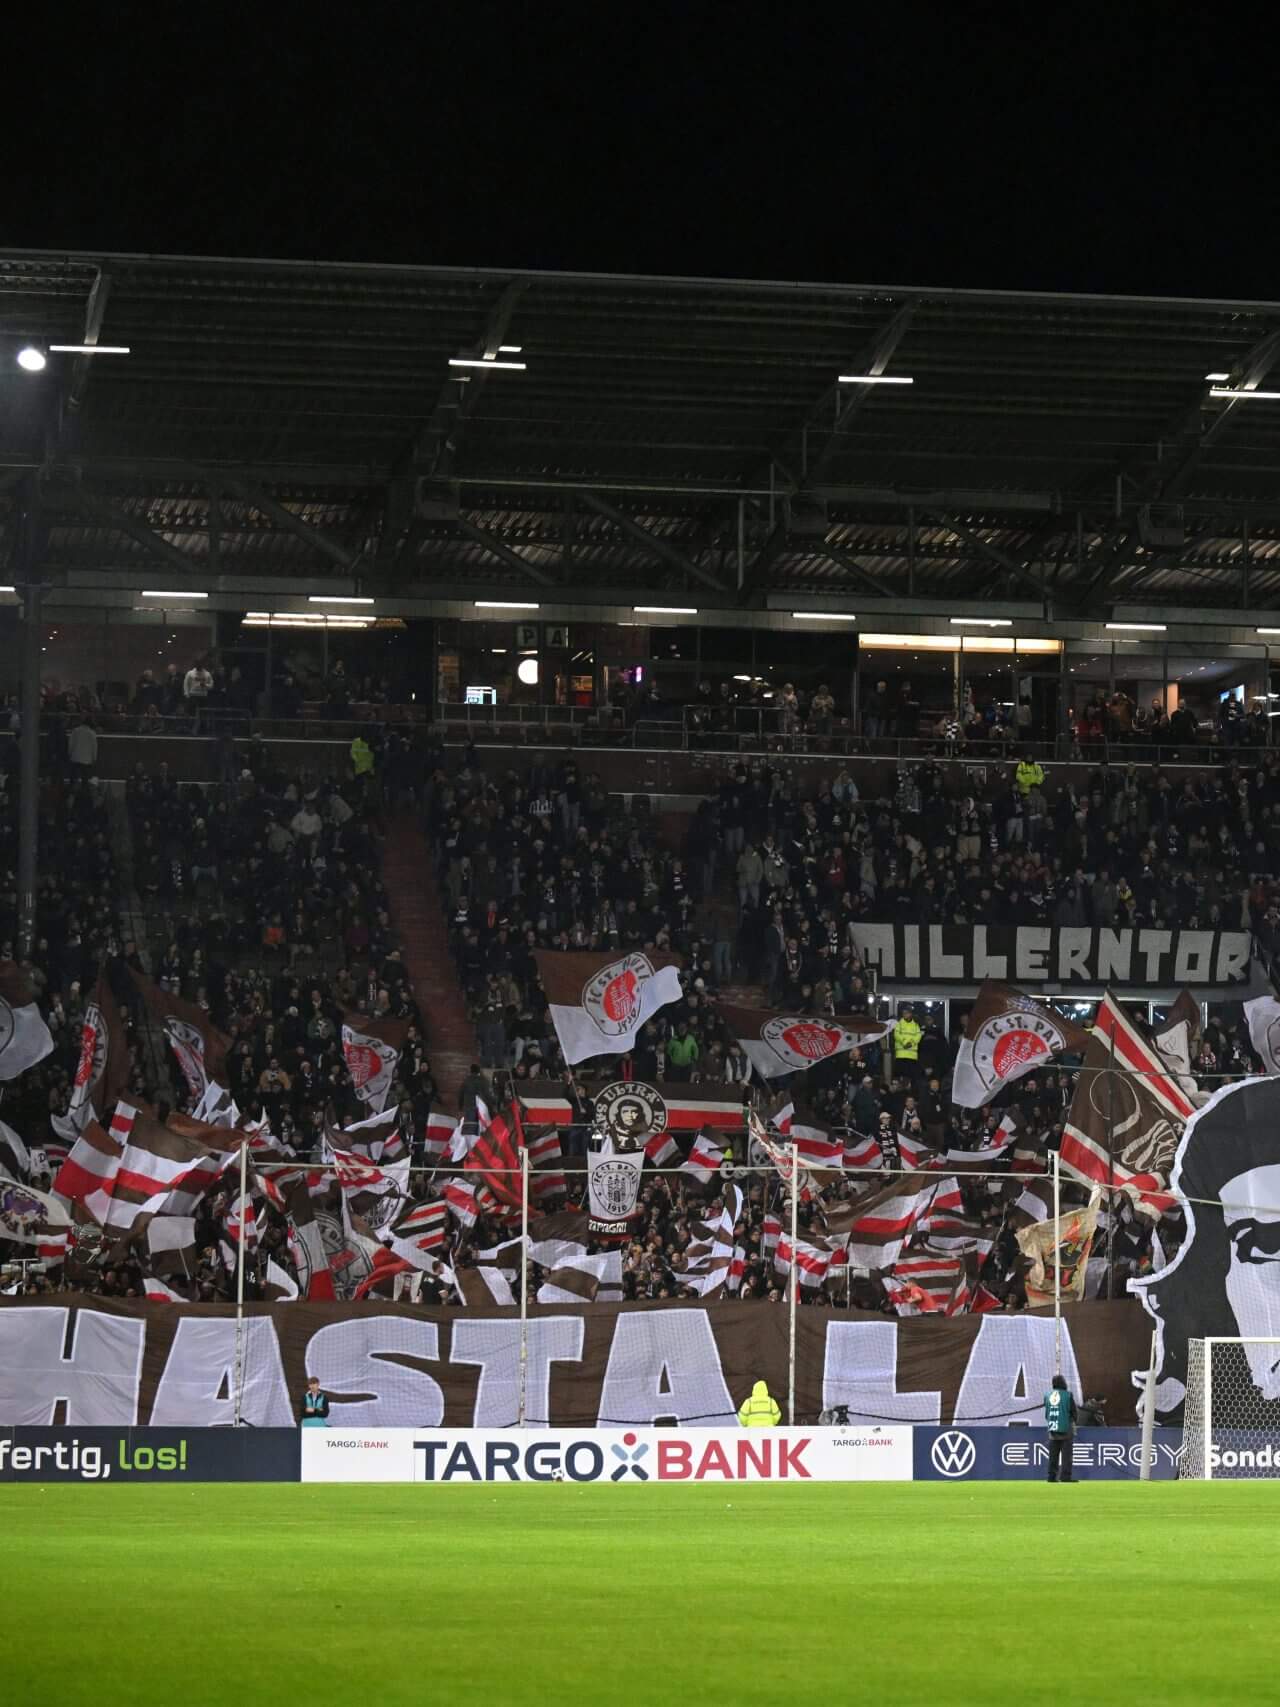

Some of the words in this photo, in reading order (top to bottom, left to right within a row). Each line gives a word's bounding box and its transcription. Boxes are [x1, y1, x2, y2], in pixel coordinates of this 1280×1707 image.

[849, 922, 1251, 983] MILLERNTOR
[985, 1022, 1003, 1040] FC
[1006, 1015, 1029, 1030] ST.
[1034, 1020, 1062, 1052] PAU
[0, 1307, 740, 1427] HASTA
[822, 1314, 1083, 1427] LA
[0, 1440, 111, 1478] fertig,
[119, 1440, 187, 1470] los!
[657, 1438, 813, 1480] BANK
